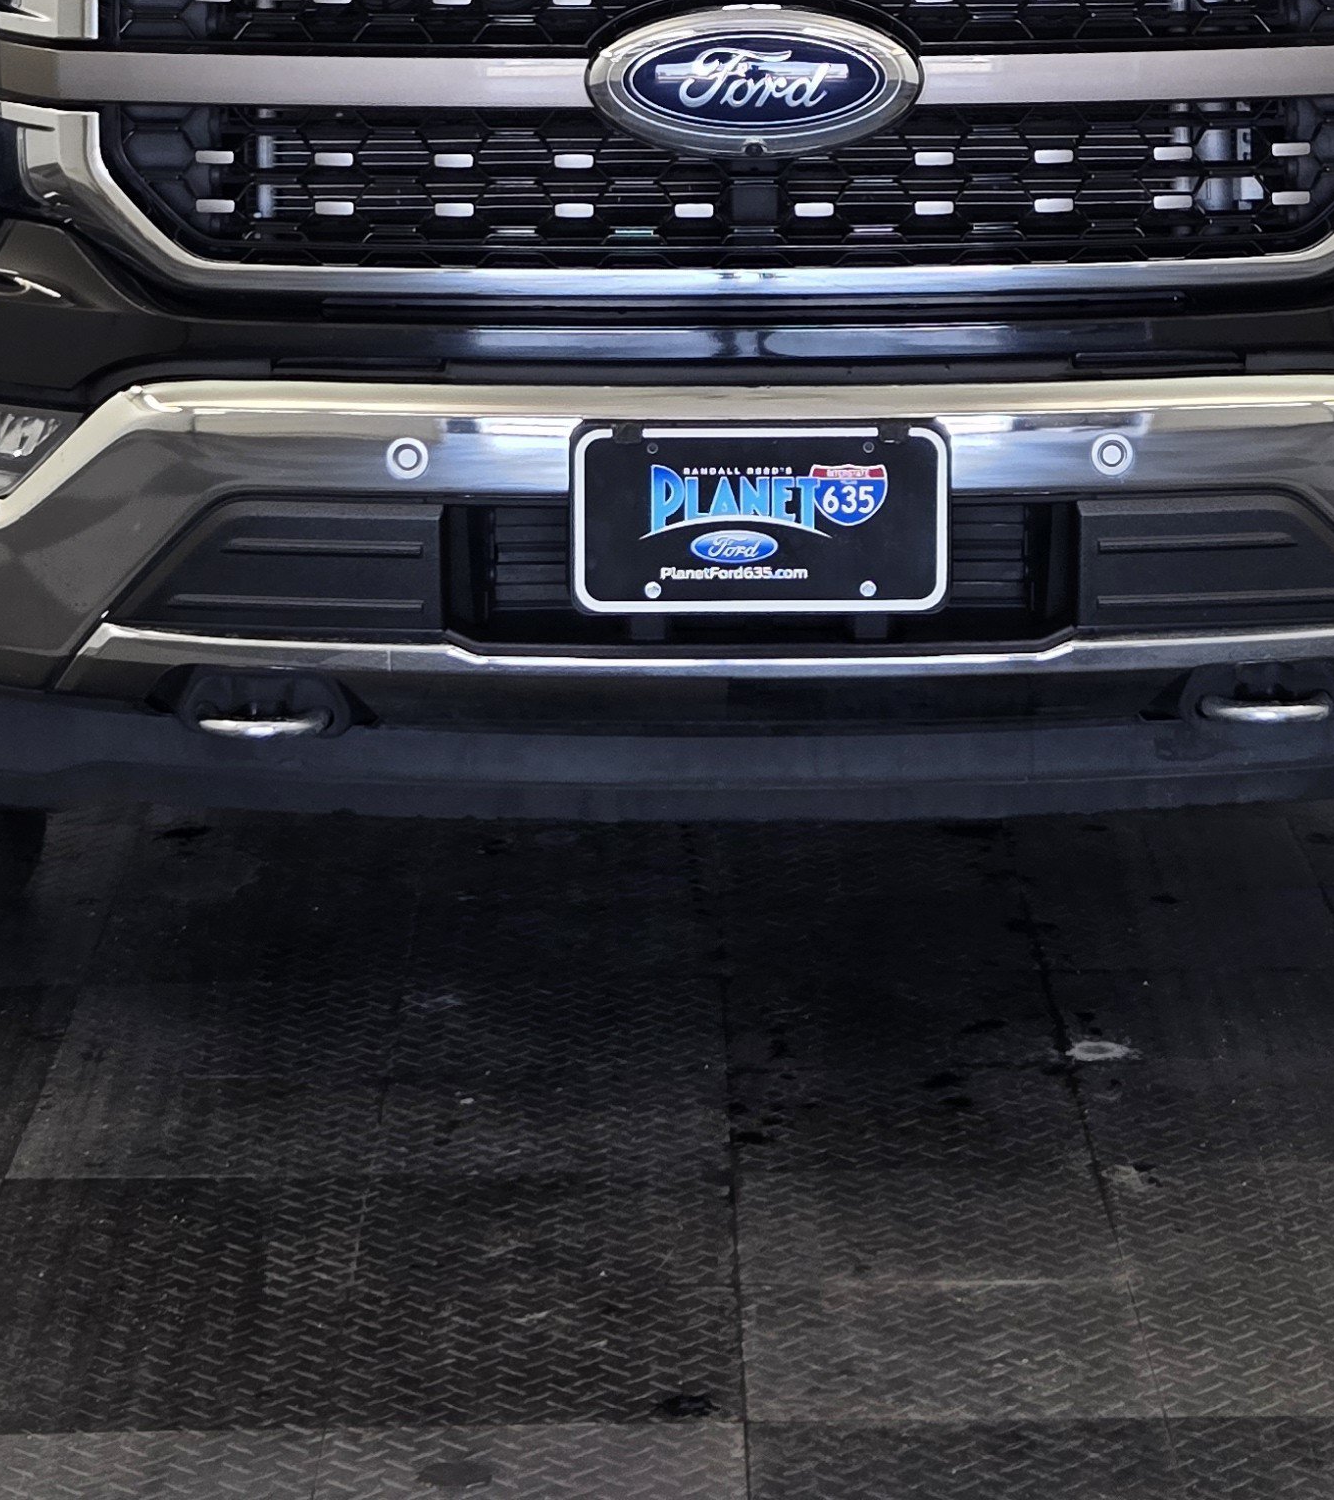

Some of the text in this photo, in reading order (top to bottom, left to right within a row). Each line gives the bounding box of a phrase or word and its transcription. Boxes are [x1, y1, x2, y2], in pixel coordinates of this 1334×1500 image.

[679, 47, 831, 108] Ford
[683, 466, 741, 476] RANDALL
[651, 464, 820, 533] PLANET
[822, 485, 875, 514] 635
[708, 534, 760, 558] Ford
[660, 565, 808, 580] PlanetFord635.com
